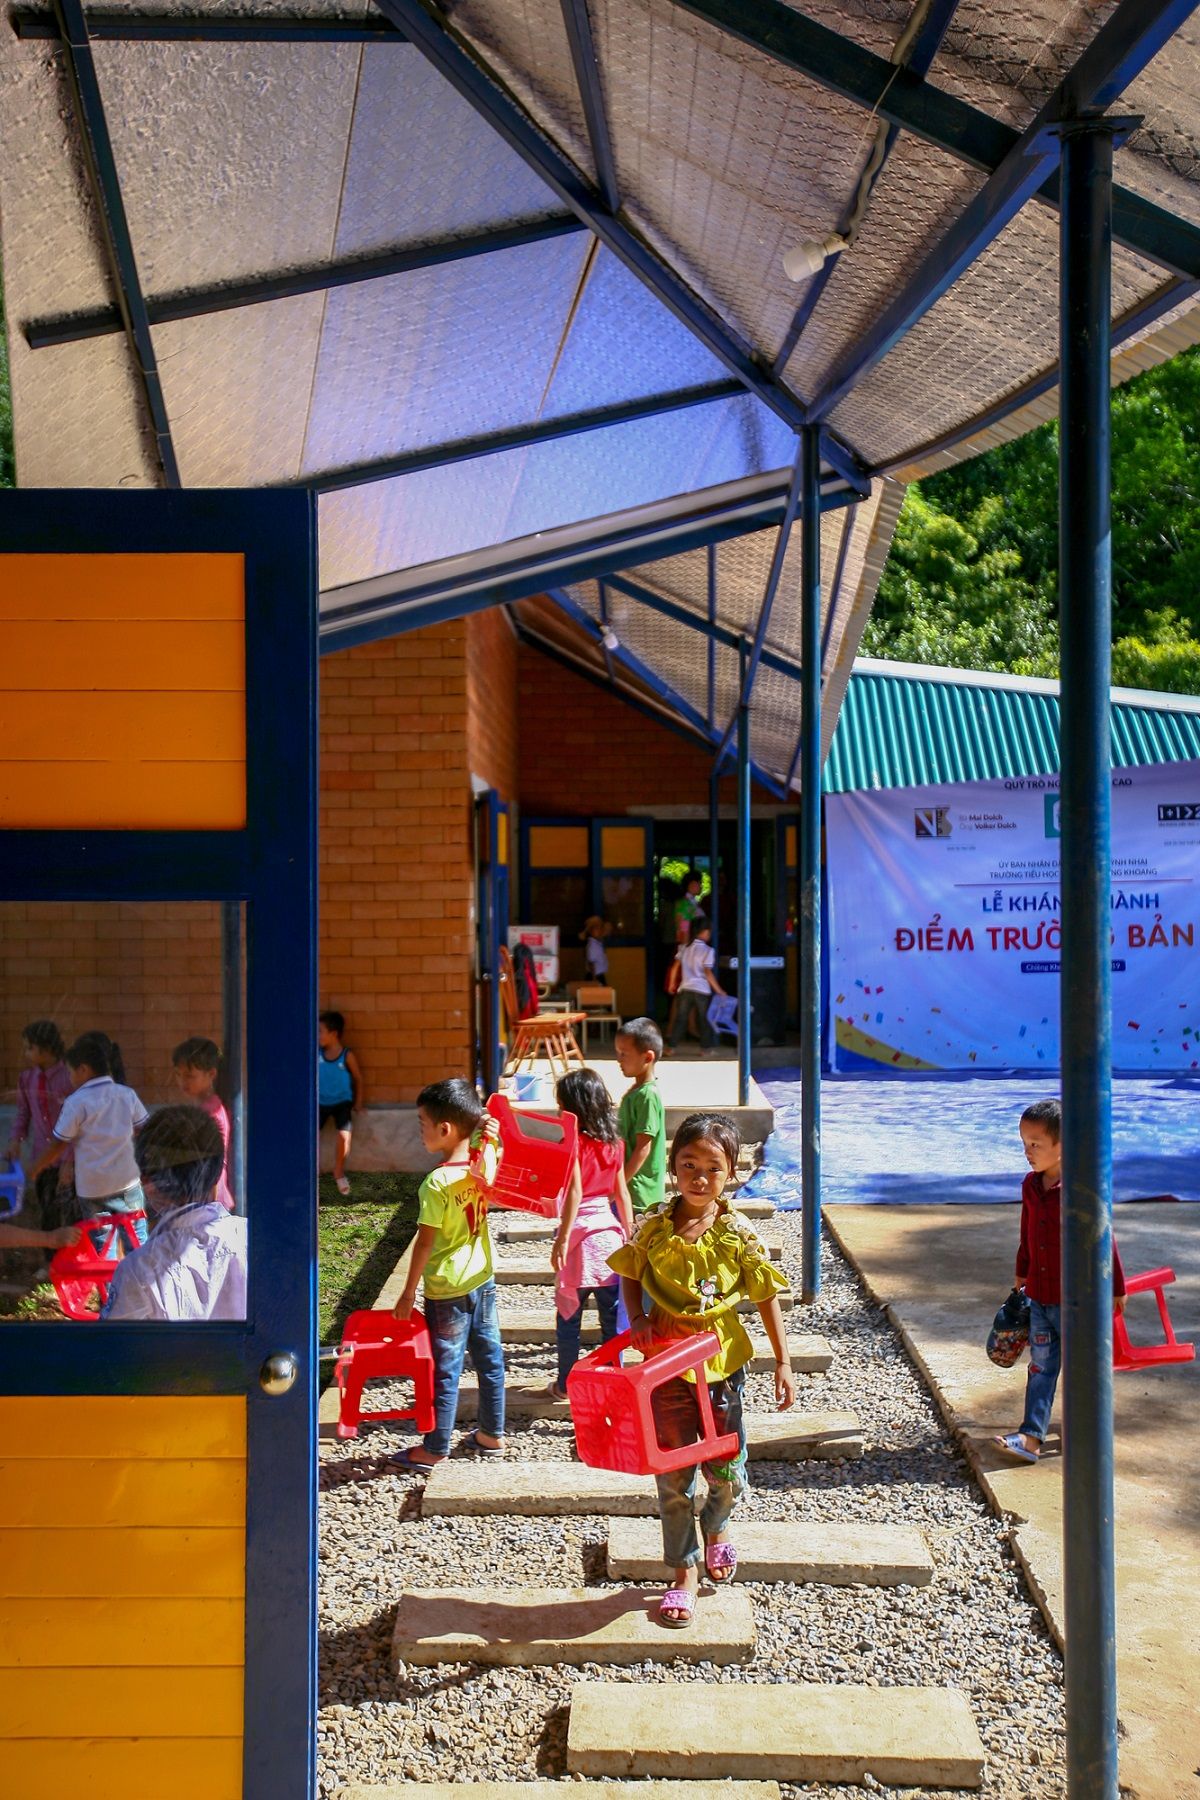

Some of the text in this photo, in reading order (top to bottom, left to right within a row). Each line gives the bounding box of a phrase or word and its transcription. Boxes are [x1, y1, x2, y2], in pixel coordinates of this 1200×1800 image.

[1112, 778, 1132, 786] CAO
[983, 813, 1003, 821] Dolch
[975, 822, 996, 830] Volker
[1010, 861, 1026, 869] BAN
[982, 890, 1004, 912] LỄ
[1008, 891, 1061, 912] KHÁN
[894, 913, 975, 951] ĐIỂM
[1128, 913, 1194, 948] BẢN
